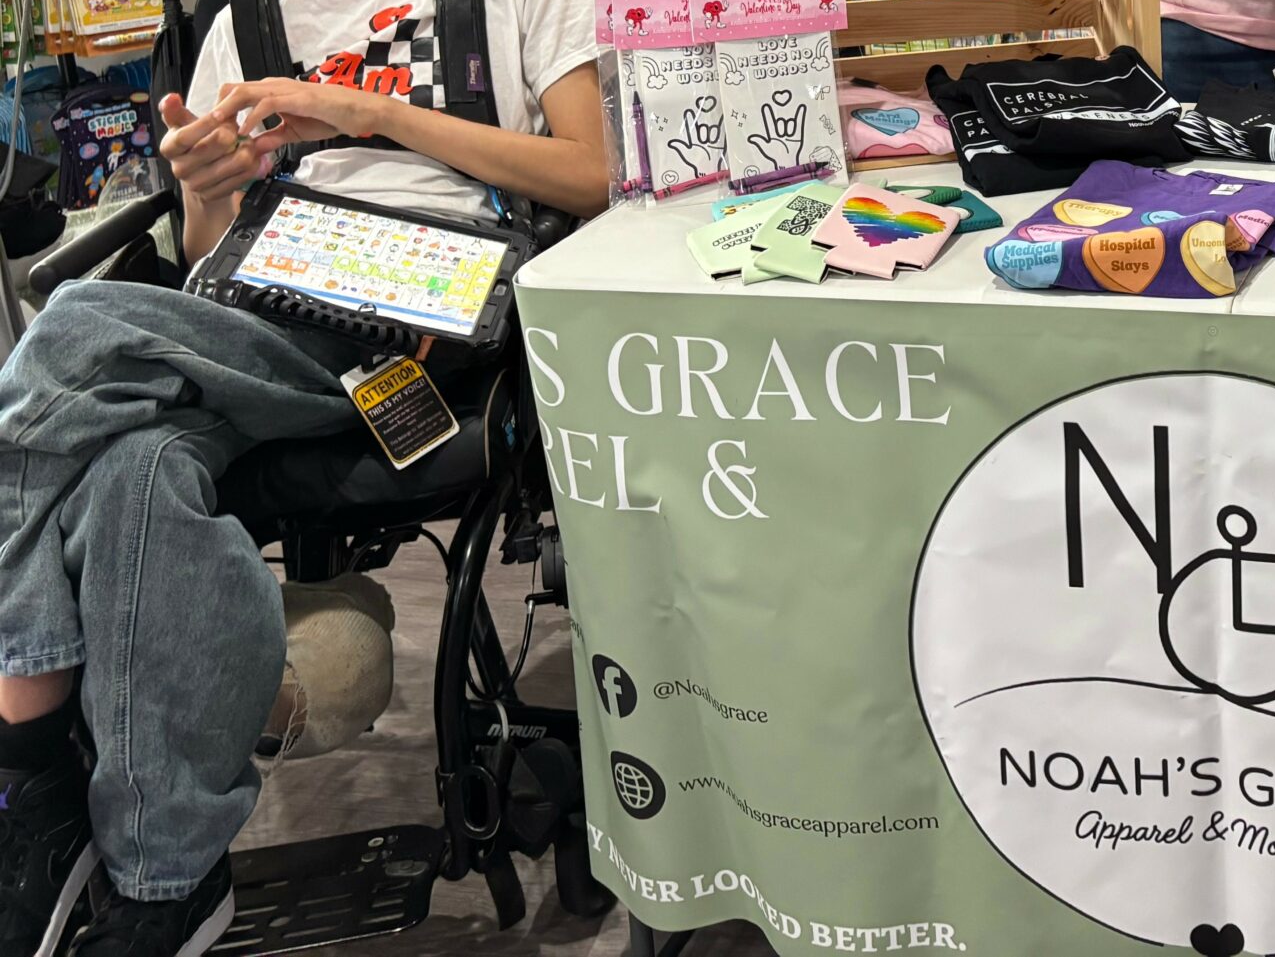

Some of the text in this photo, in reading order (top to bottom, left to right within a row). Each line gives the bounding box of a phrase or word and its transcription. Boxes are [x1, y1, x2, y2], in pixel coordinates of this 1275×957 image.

[683, 45, 715, 56] LOV
[757, 36, 797, 52] LOVE
[661, 58, 714, 73] NEEDS
[738, 48, 814, 69] NEEDS NO
[321, 51, 414, 96] Am
[753, 63, 809, 80] WORDS
[1004, 91, 1089, 104] CEREBRAL
[88, 114, 137, 130] STICKER
[96, 125, 133, 138] MAGIC
[1068, 201, 1123, 216] Therapy
[1004, 243, 1057, 258] Medical
[1100, 238, 1155, 253] Hospital
[1000, 251, 1060, 270] Supplies
[1111, 260, 1149, 272] Stays
[361, 364, 417, 406] ATTENTION
[608, 332, 952, 425] GRACE
[368, 405, 385, 419] THIS
[385, 400, 392, 410] IS
[392, 392, 403, 404] MY
[702, 439, 770, 520] &
[653, 678, 769, 724] @Noahsgrace
[1000, 747, 1222, 798] NOAH'S
[678, 775, 940, 838] www.noahsgraceapparel.com
[1075, 810, 1193, 850] Apparel
[1203, 810, 1228, 842] &
[608, 837, 967, 952] NEVER LOOKED BETTER.
